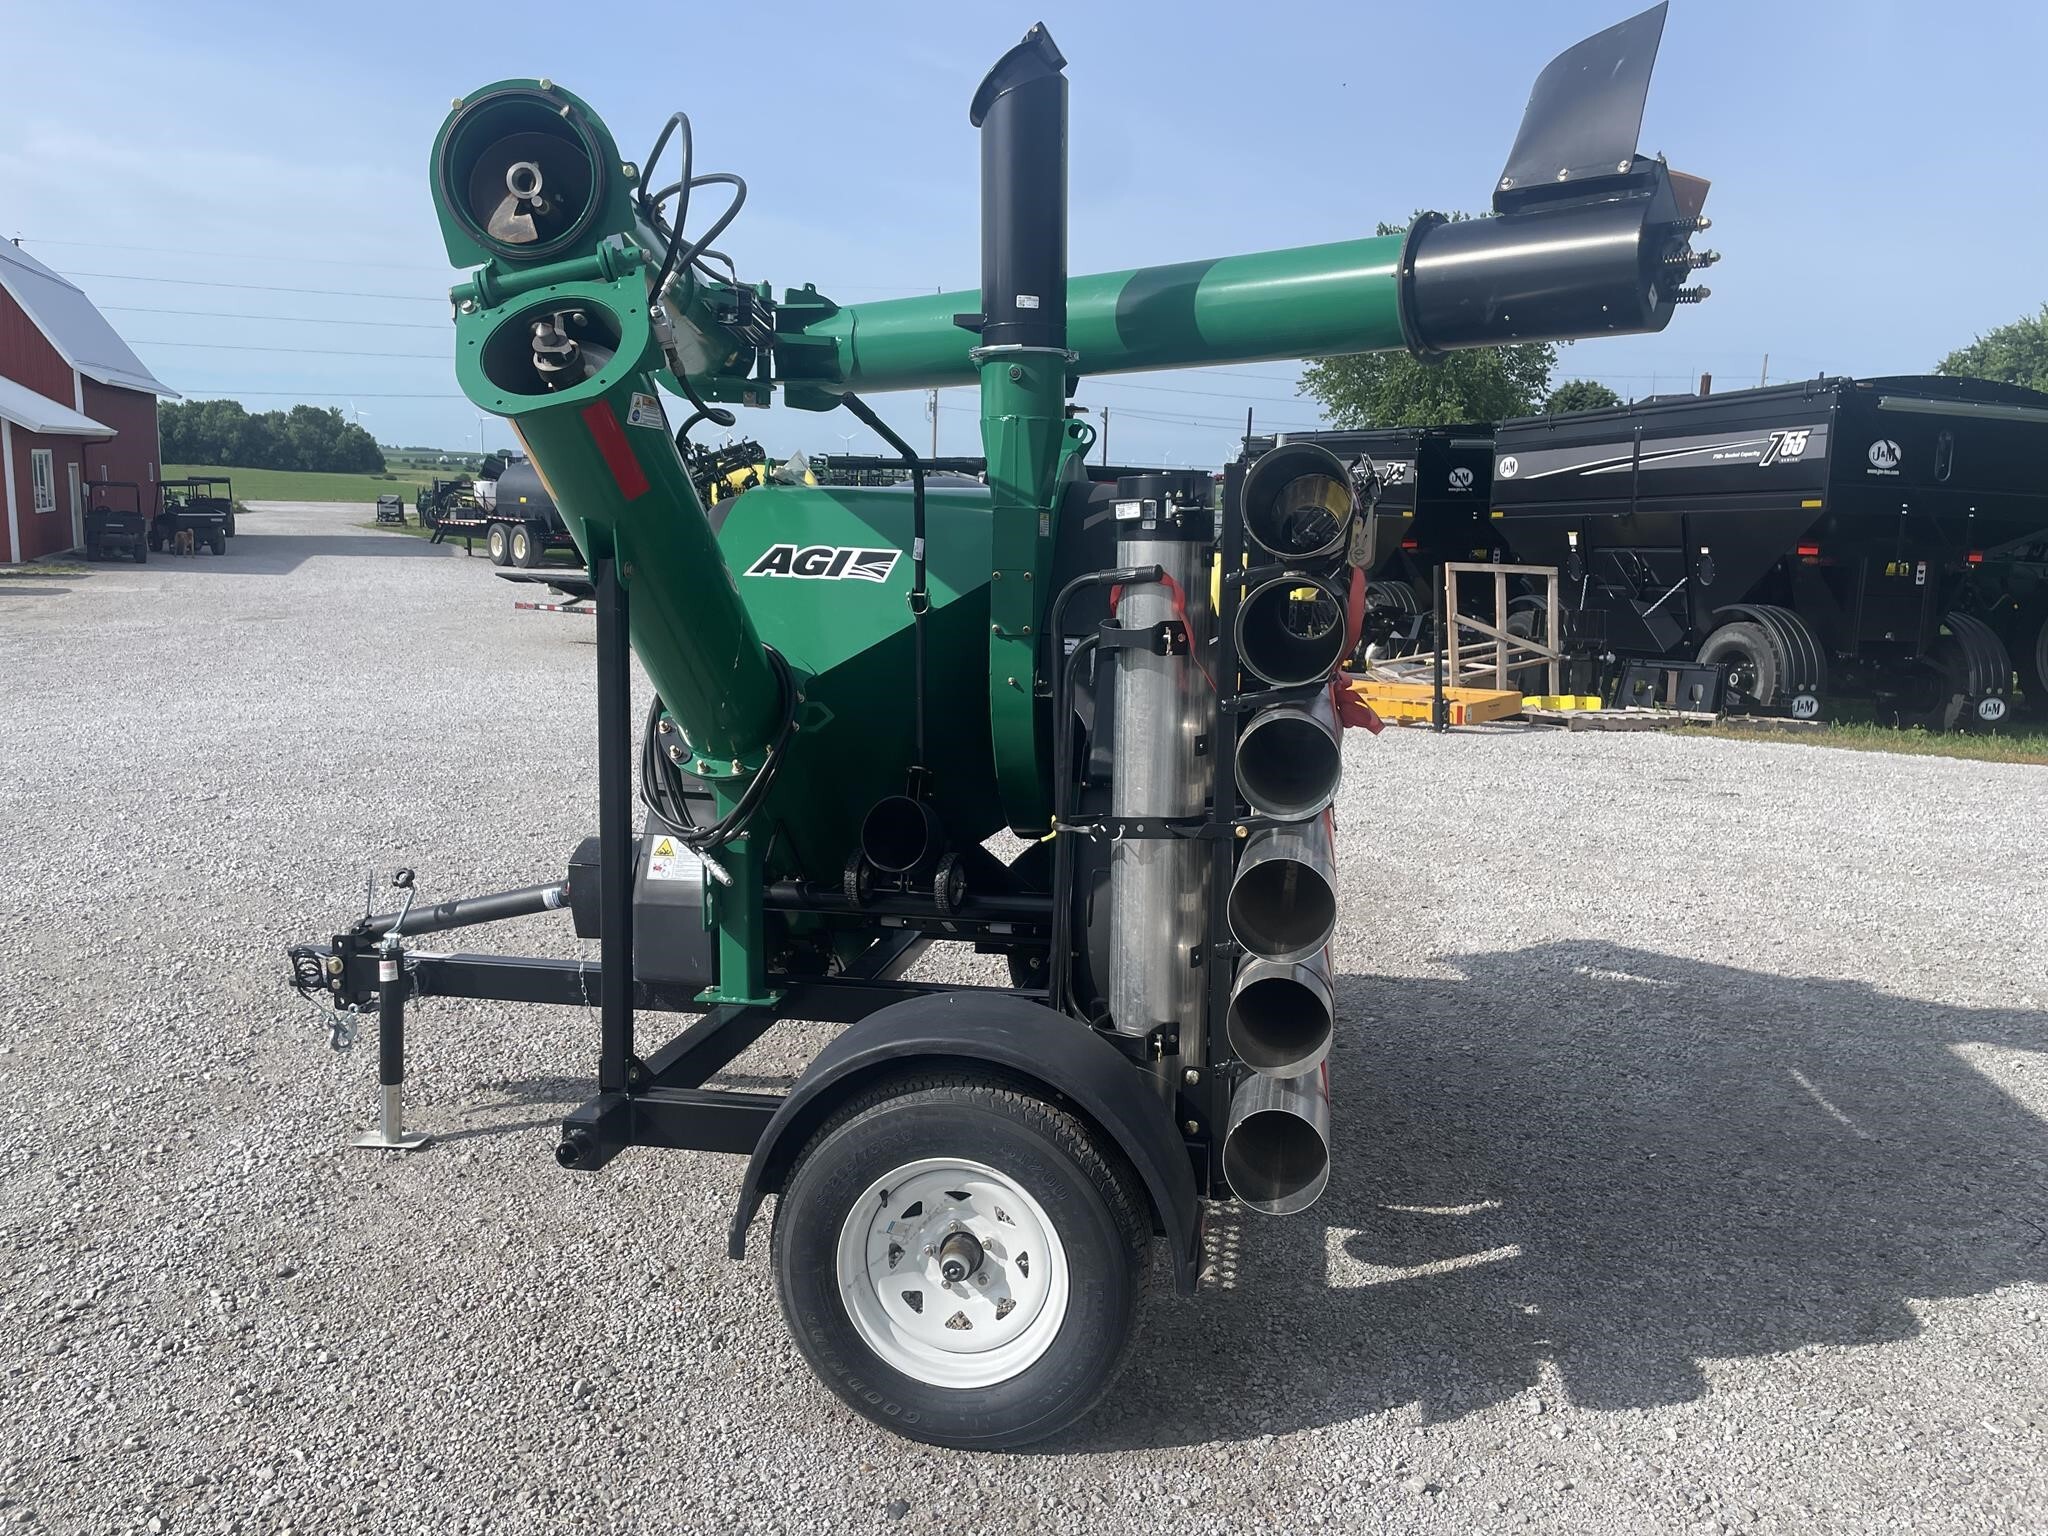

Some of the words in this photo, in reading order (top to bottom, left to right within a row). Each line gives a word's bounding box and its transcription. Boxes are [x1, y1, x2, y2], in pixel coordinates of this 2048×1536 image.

[1759, 430, 1810, 467] 755
[1872, 446, 1896, 461] J&M
[751, 547, 853, 577] AGI
[1794, 700, 1813, 712] J&M
[1981, 703, 2000, 715] J&M
